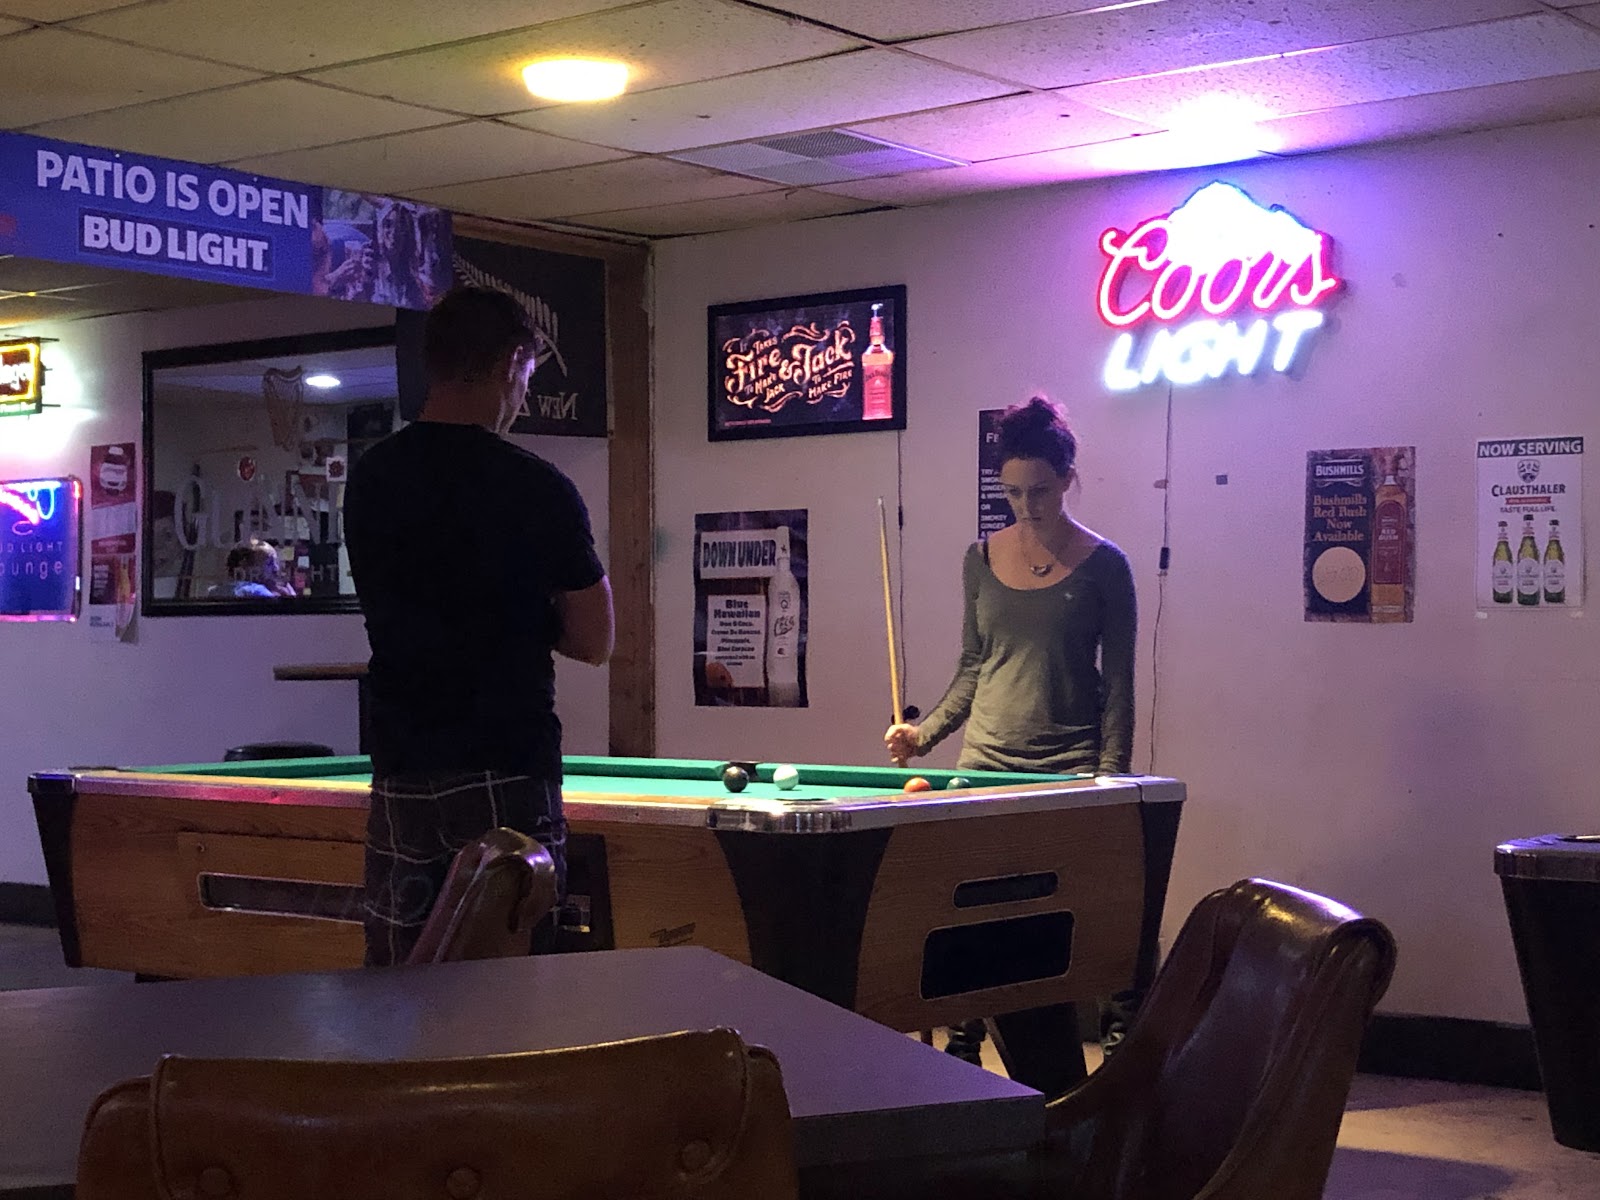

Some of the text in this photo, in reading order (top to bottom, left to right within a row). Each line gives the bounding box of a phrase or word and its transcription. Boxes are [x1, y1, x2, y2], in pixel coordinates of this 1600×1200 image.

[36, 149, 309, 229] PATIO IS OPEN
[83, 214, 269, 273] BUD LIGHT
[1097, 218, 1338, 328] Coors
[725, 348, 782, 394] Fire
[791, 322, 856, 385] Jack
[1103, 309, 1325, 391] LIGHT
[1479, 440, 1582, 457] NOW SERVING
[1315, 464, 1365, 477] BUSHMILLS
[1491, 482, 1566, 497] CLAUSTHALER
[1313, 493, 1367, 506] Bushmills
[1326, 518, 1353, 529] Now
[1312, 530, 1365, 542] Available
[702, 539, 777, 569] DOWN UNDER
[725, 600, 749, 609] Blue
